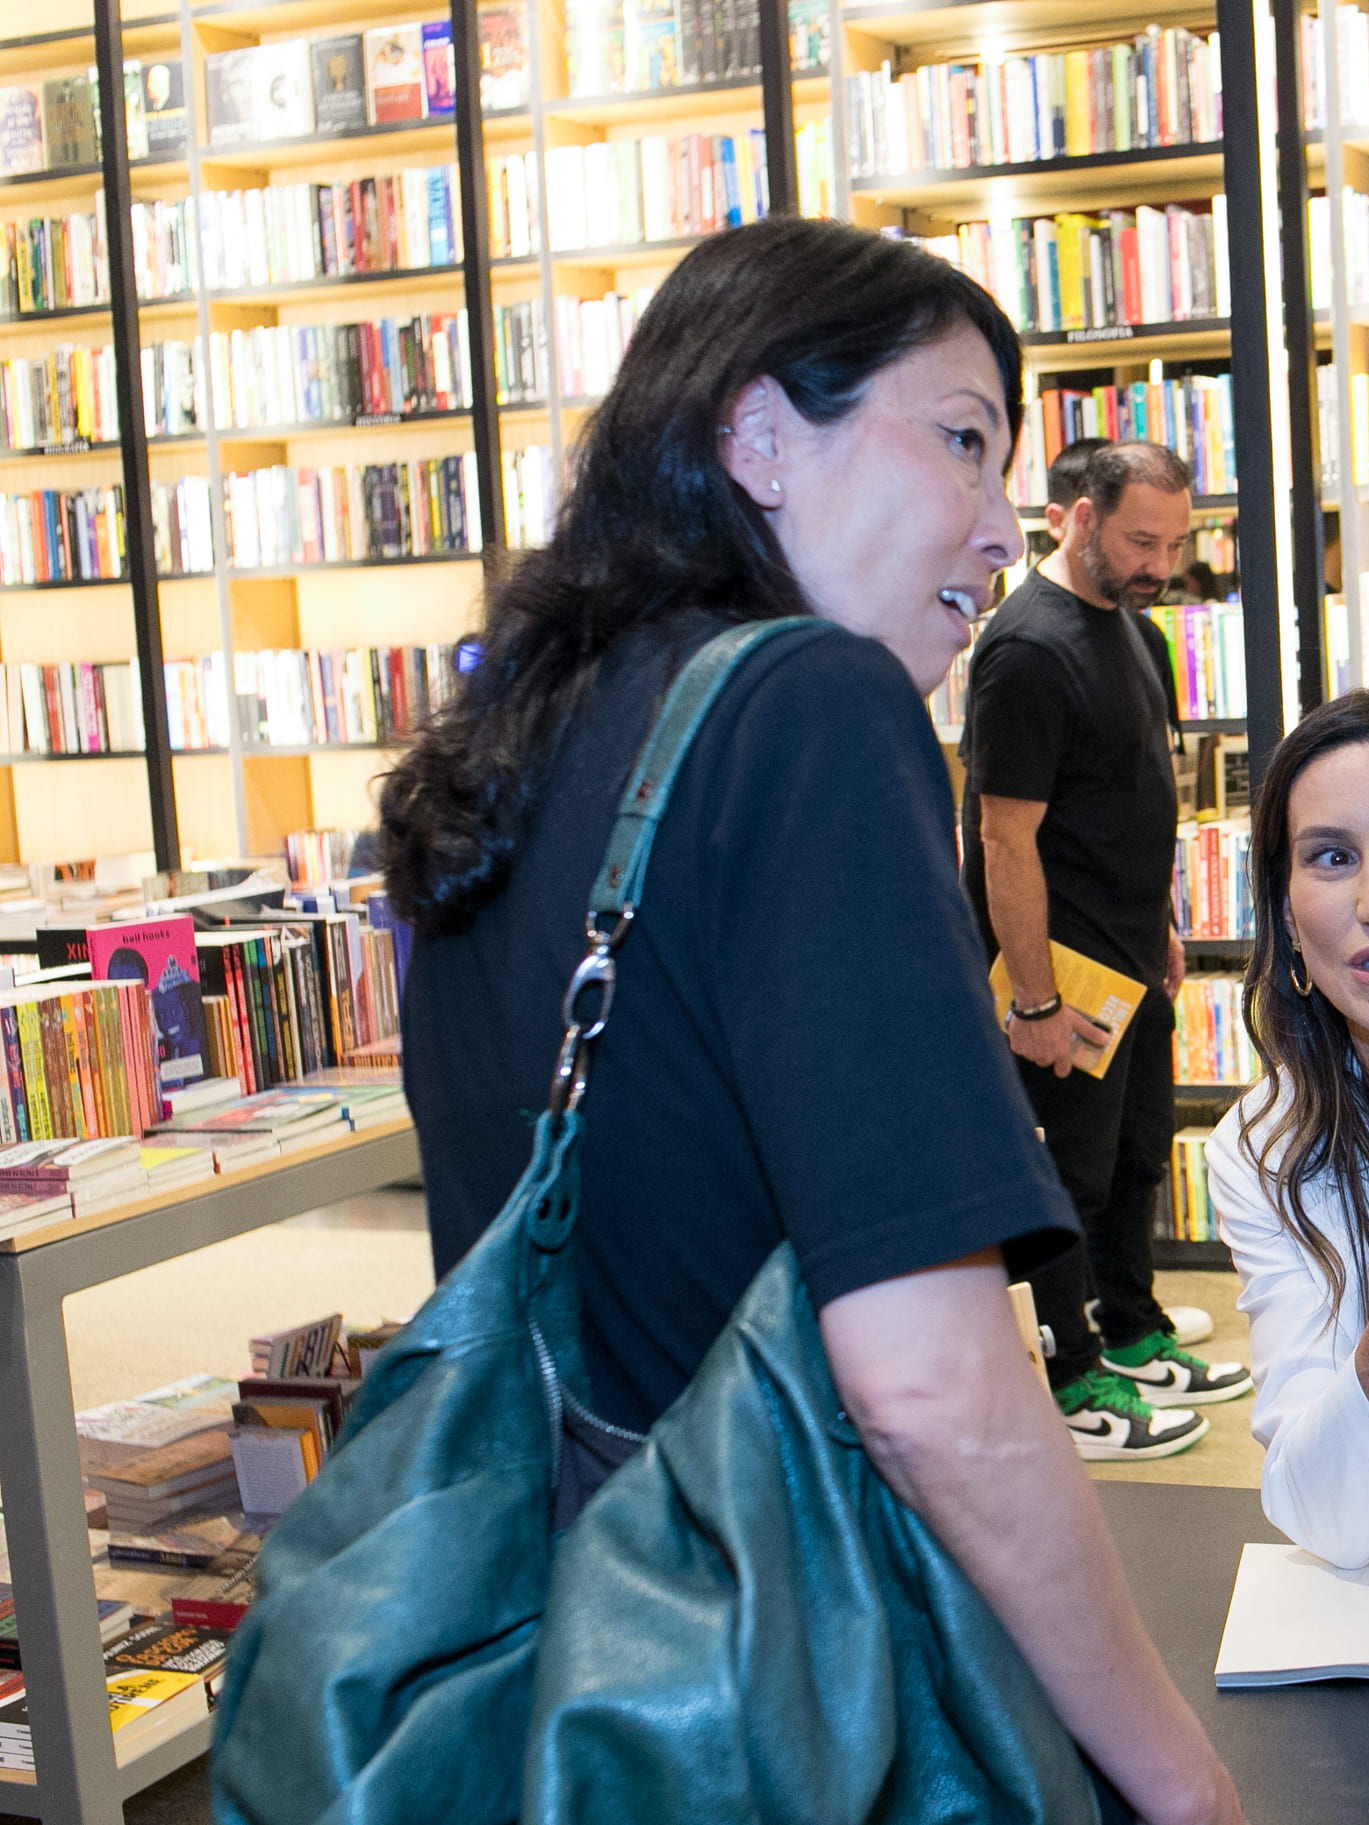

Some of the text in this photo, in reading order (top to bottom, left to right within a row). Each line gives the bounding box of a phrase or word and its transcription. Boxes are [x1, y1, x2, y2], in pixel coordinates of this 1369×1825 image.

[1067, 325, 1134, 344] FILOSOFIA
[123, 929, 170, 945] bell hooks
